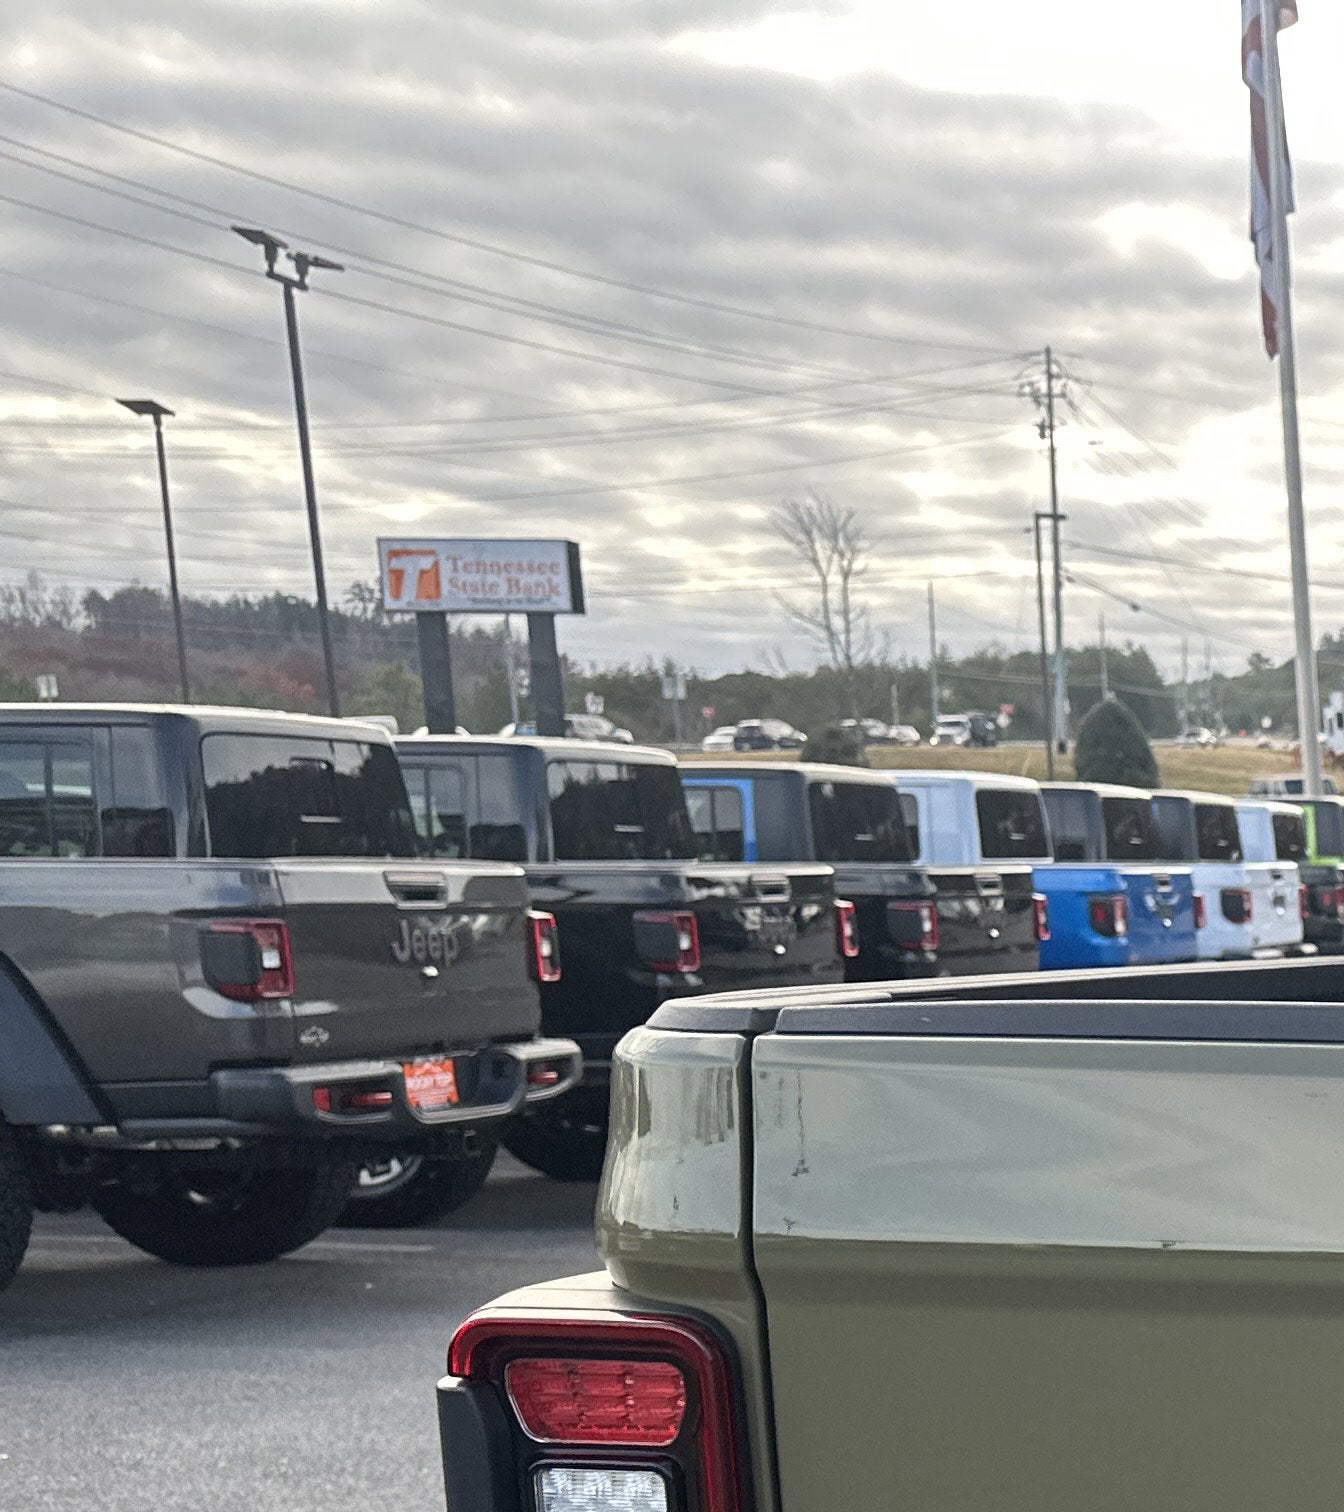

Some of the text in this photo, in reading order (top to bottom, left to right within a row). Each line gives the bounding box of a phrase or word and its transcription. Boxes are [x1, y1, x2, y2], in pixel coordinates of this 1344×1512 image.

[446, 555, 561, 576] Tennessee
[448, 576, 561, 597] State Bank
[391, 918, 459, 968] Jeep
